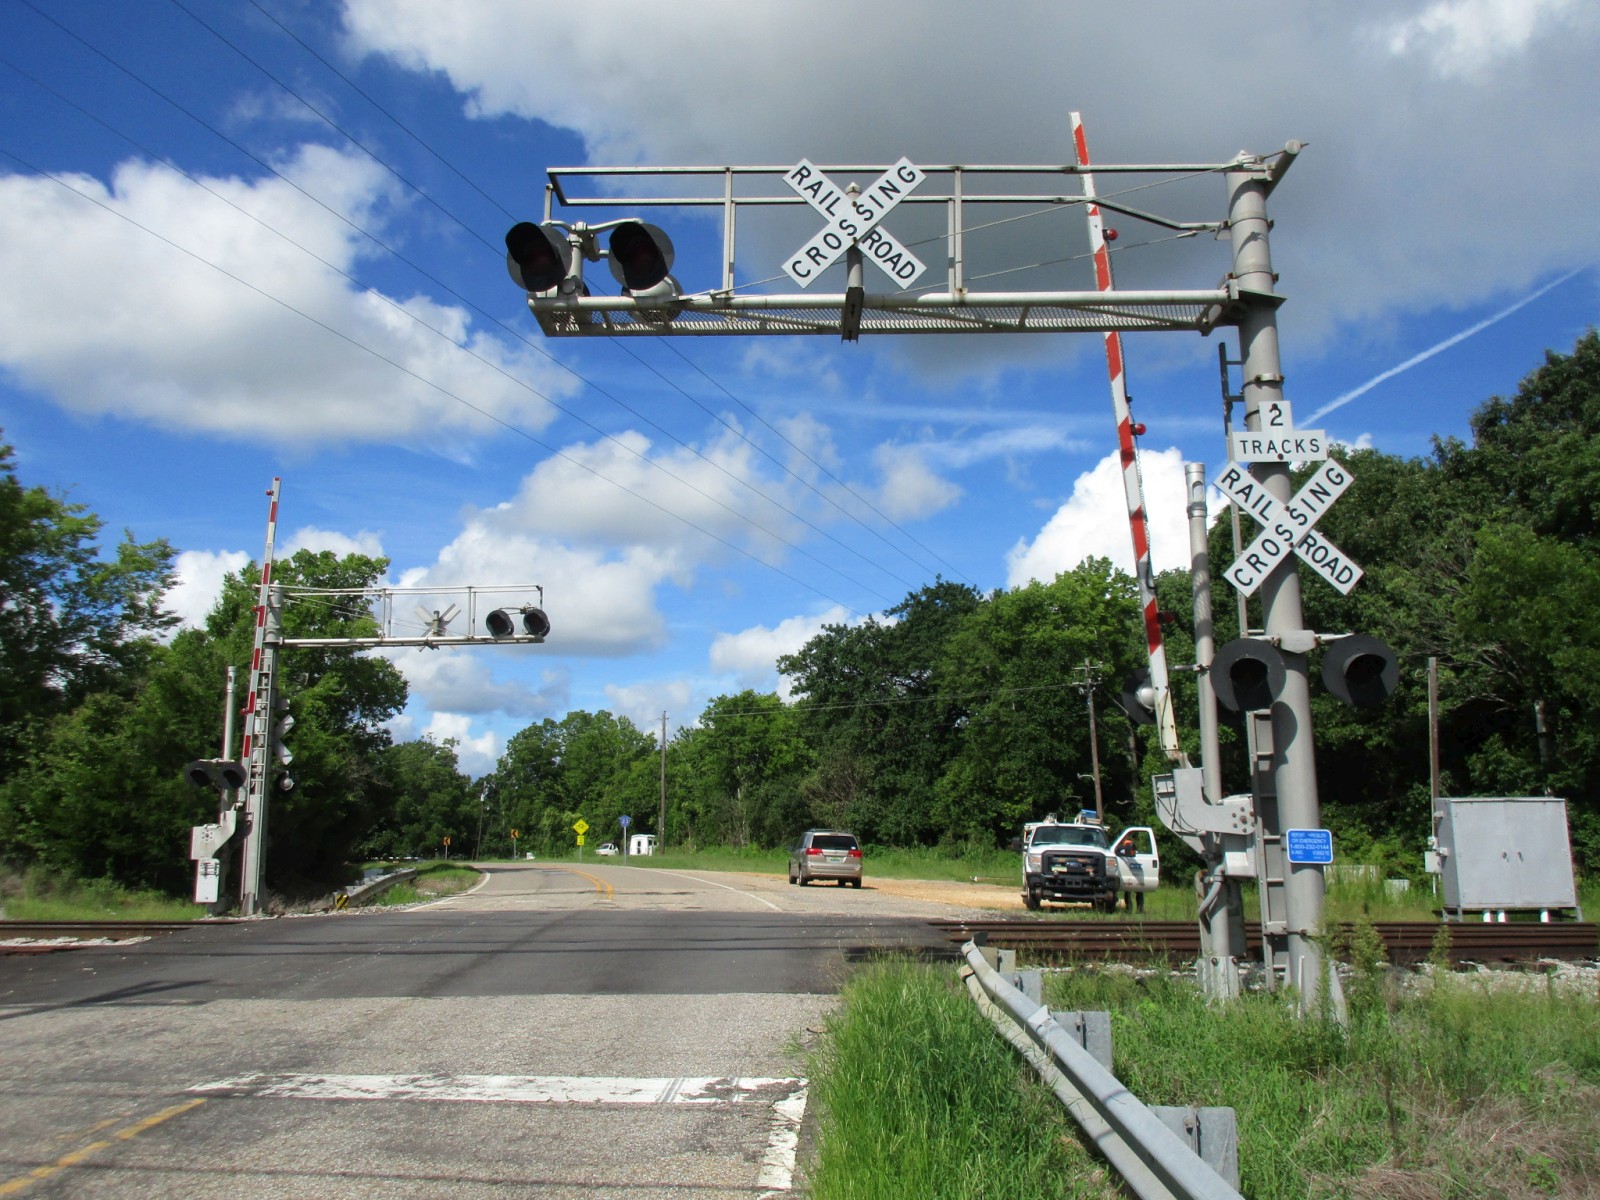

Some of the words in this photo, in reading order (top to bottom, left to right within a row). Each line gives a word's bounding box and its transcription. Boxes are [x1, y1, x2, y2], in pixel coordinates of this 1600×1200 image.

[790, 165, 841, 217] RAIL
[861, 229, 916, 280] ROAD
[791, 165, 917, 279] CROSSING
[1239, 438, 1320, 454] TRACKS
[1269, 407, 1284, 427] 2
[1221, 468, 1273, 522] RAIL
[1298, 534, 1354, 586] ROAD
[1234, 467, 1344, 587] CROSSING
